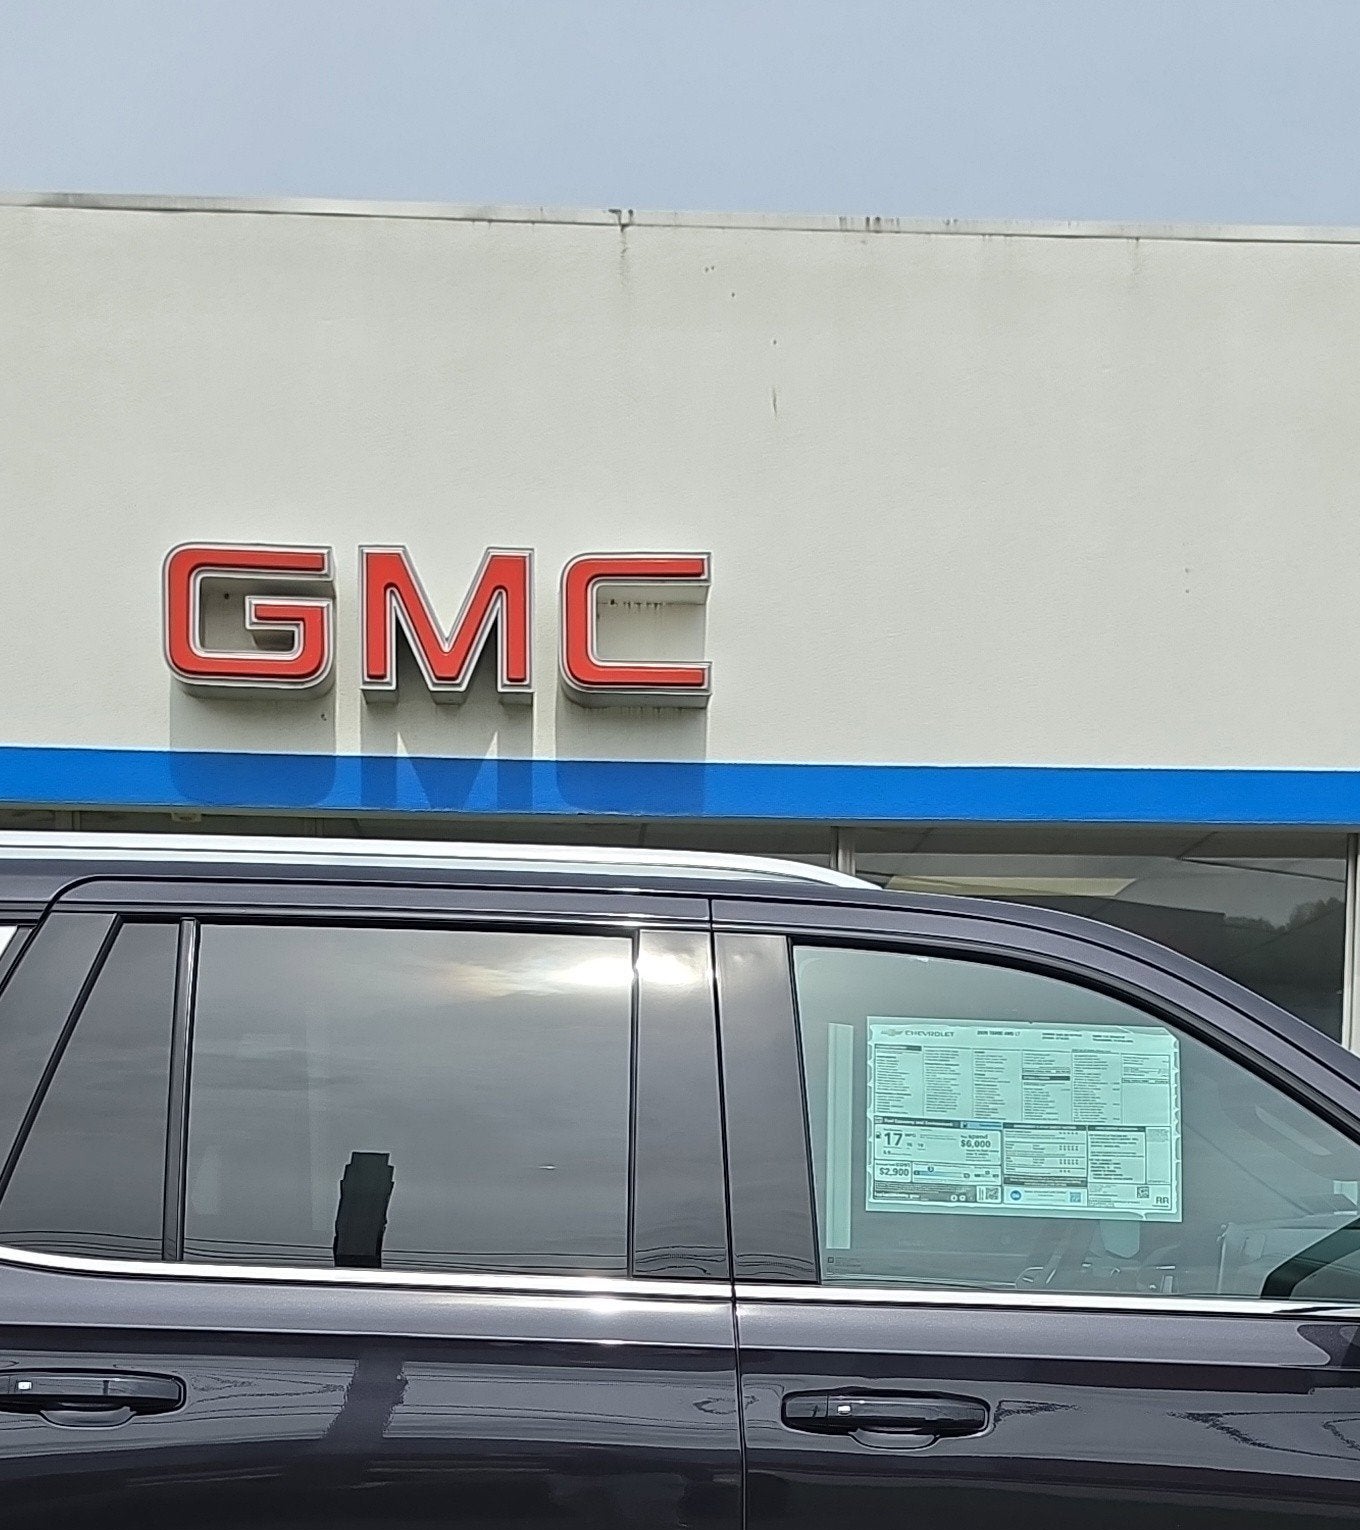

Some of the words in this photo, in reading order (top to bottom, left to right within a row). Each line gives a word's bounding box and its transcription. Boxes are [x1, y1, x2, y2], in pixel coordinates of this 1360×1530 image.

[162, 542, 712, 706] GMC
[884, 1132, 902, 1146] 17
[960, 1139, 991, 1149] $6,000
[879, 1167, 909, 1176] $2,900
